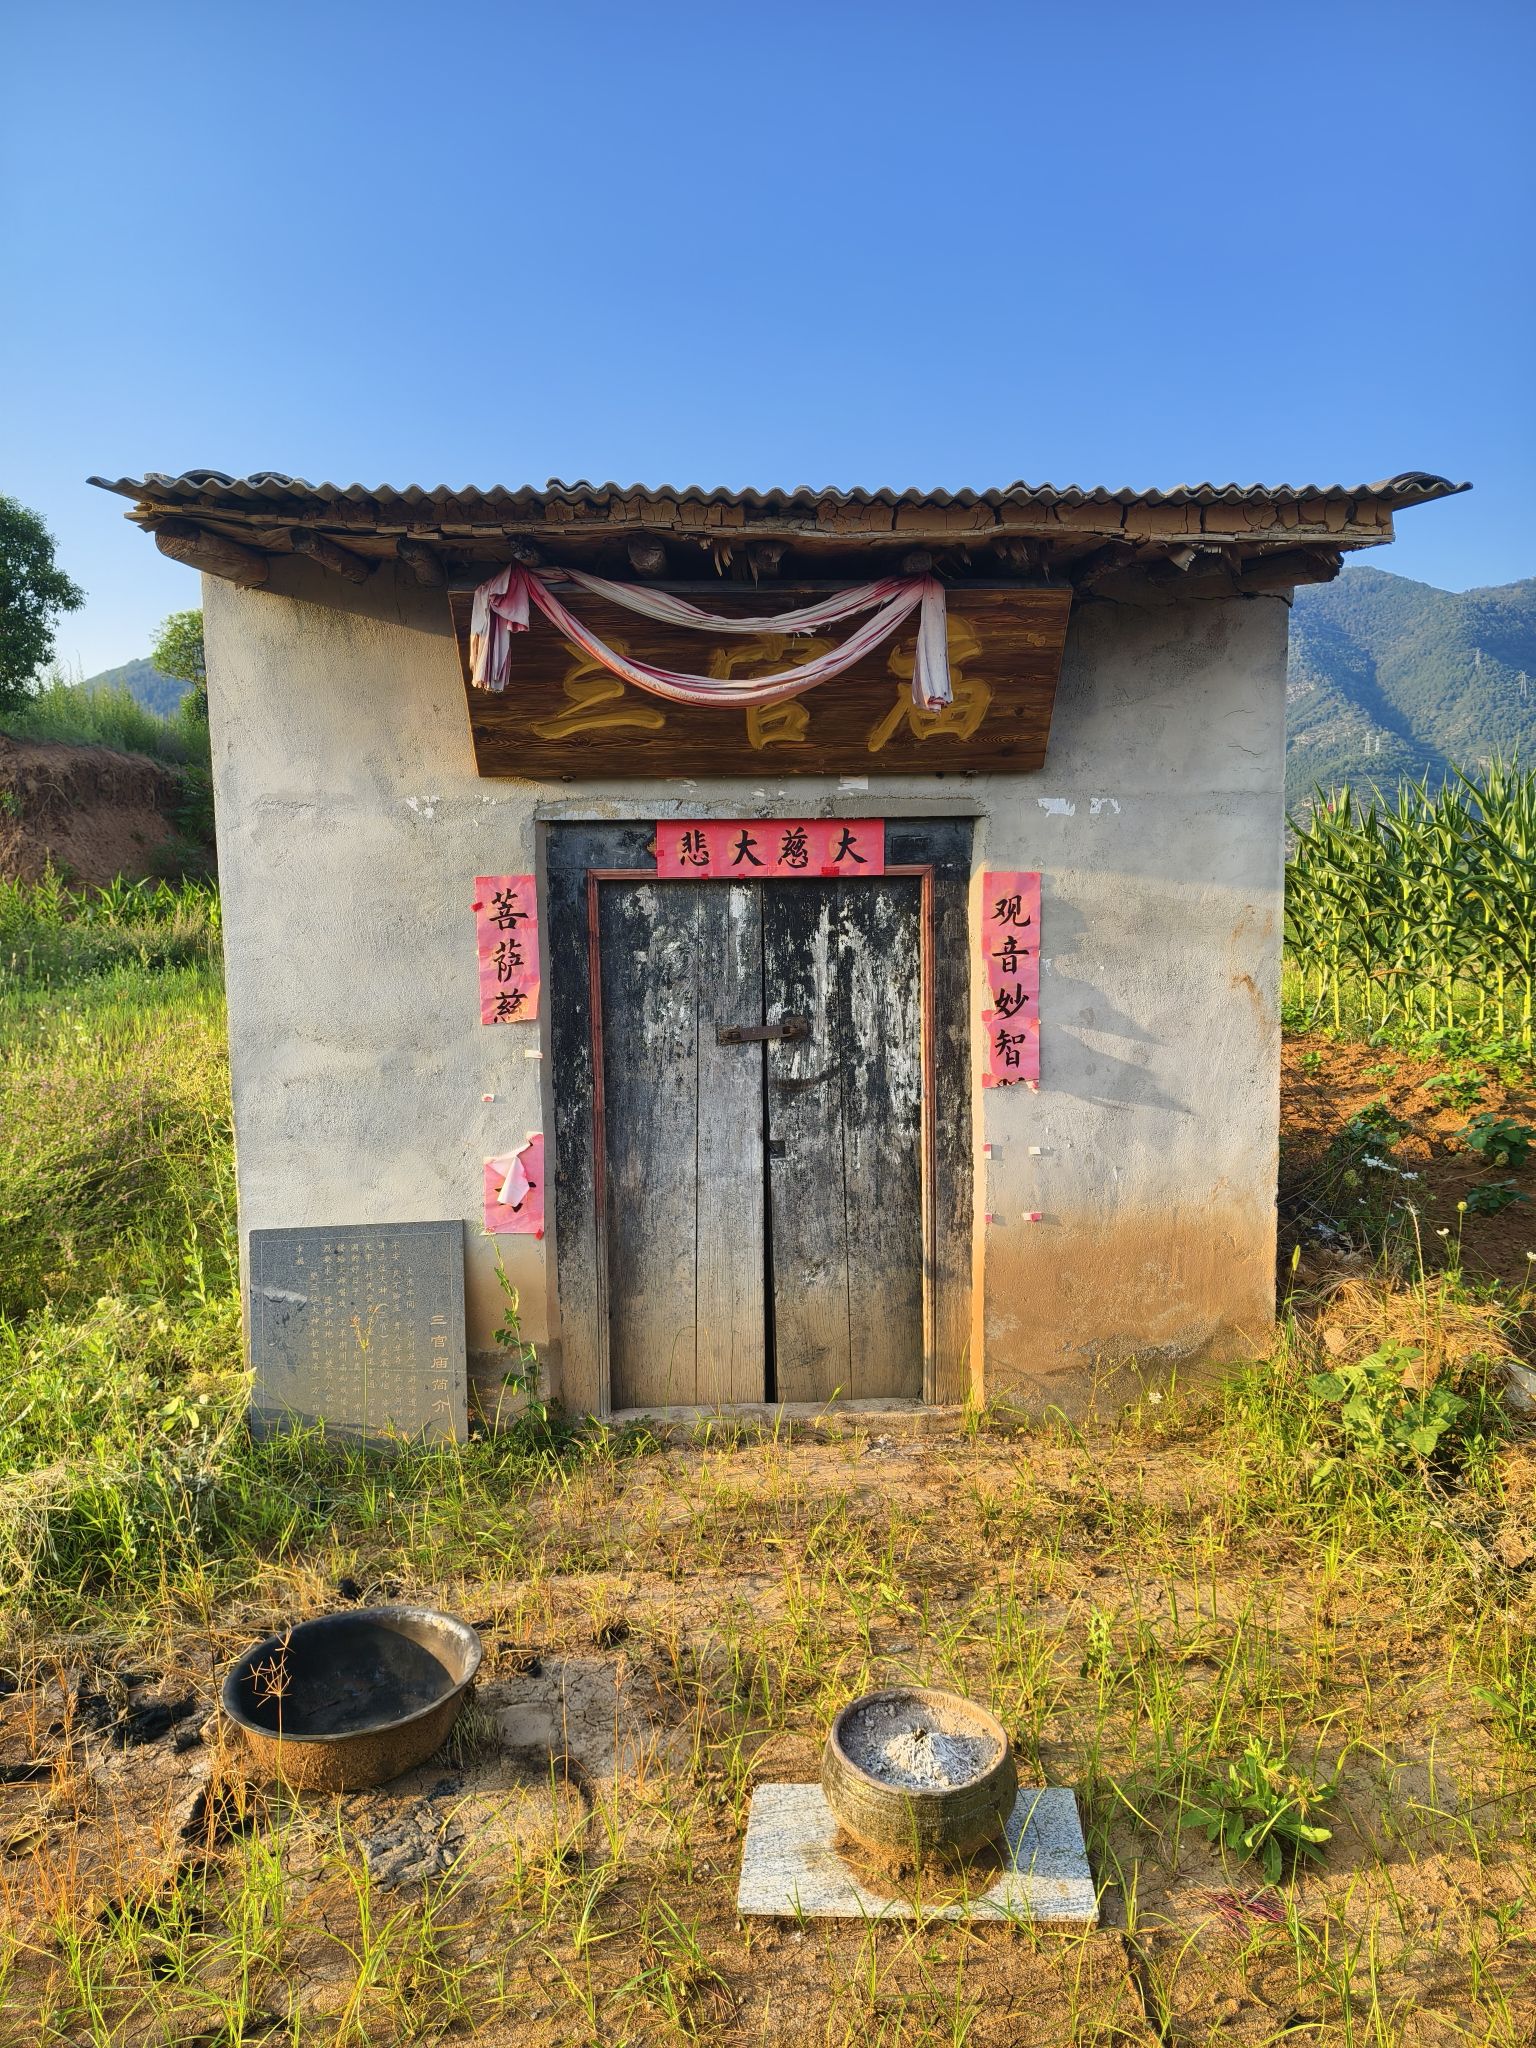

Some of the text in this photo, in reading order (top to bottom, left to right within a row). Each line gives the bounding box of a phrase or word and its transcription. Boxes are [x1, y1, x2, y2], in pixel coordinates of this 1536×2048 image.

[991, 894, 1031, 1087] 观音妙智
[429, 1314, 449, 1413] 三官庙简介
